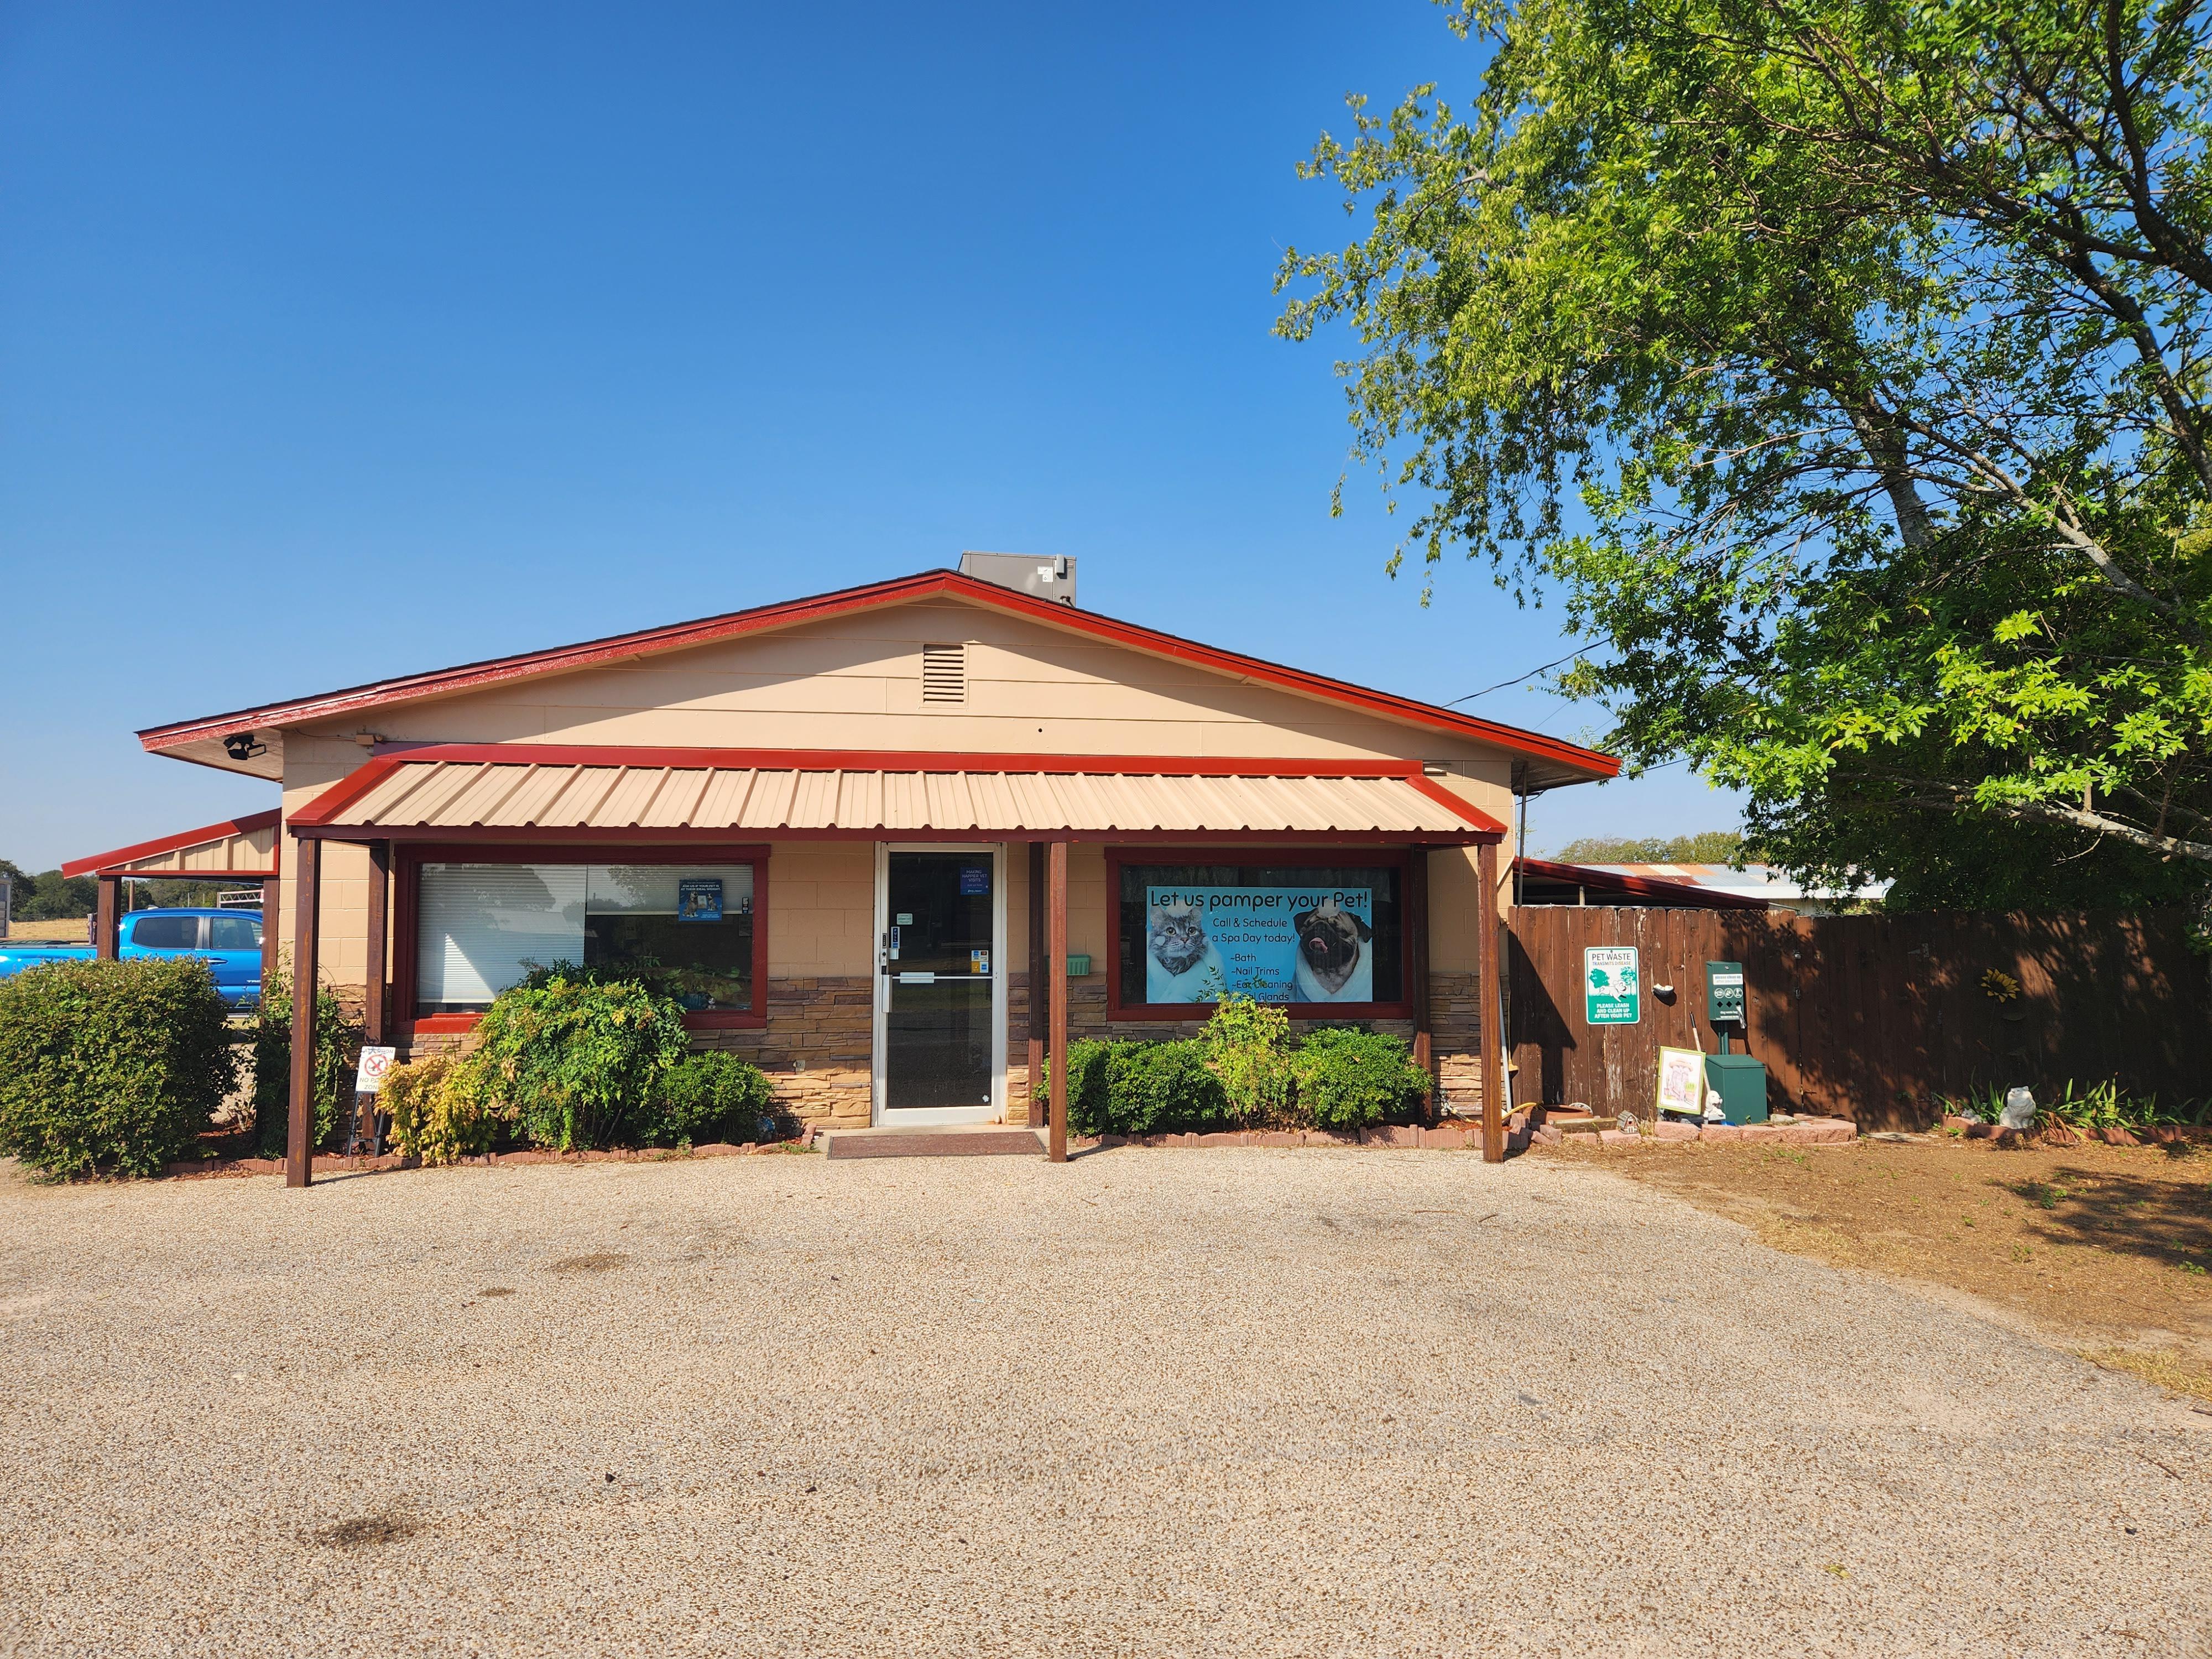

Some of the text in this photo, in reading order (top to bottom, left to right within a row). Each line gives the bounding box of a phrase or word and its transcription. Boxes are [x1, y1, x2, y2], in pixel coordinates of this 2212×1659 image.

[1151, 890, 1368, 912] Let us pamper your Pet!
[1213, 917, 1287, 927] Call & Schedule
[1220, 933, 1240, 945] Spa
[1243, 933, 1262, 945] Day
[1264, 933, 1295, 945] today!
[1255, 967, 1280, 975] Trims
[1254, 980, 1293, 990] eaning
[1258, 992, 1290, 1001] Glands
